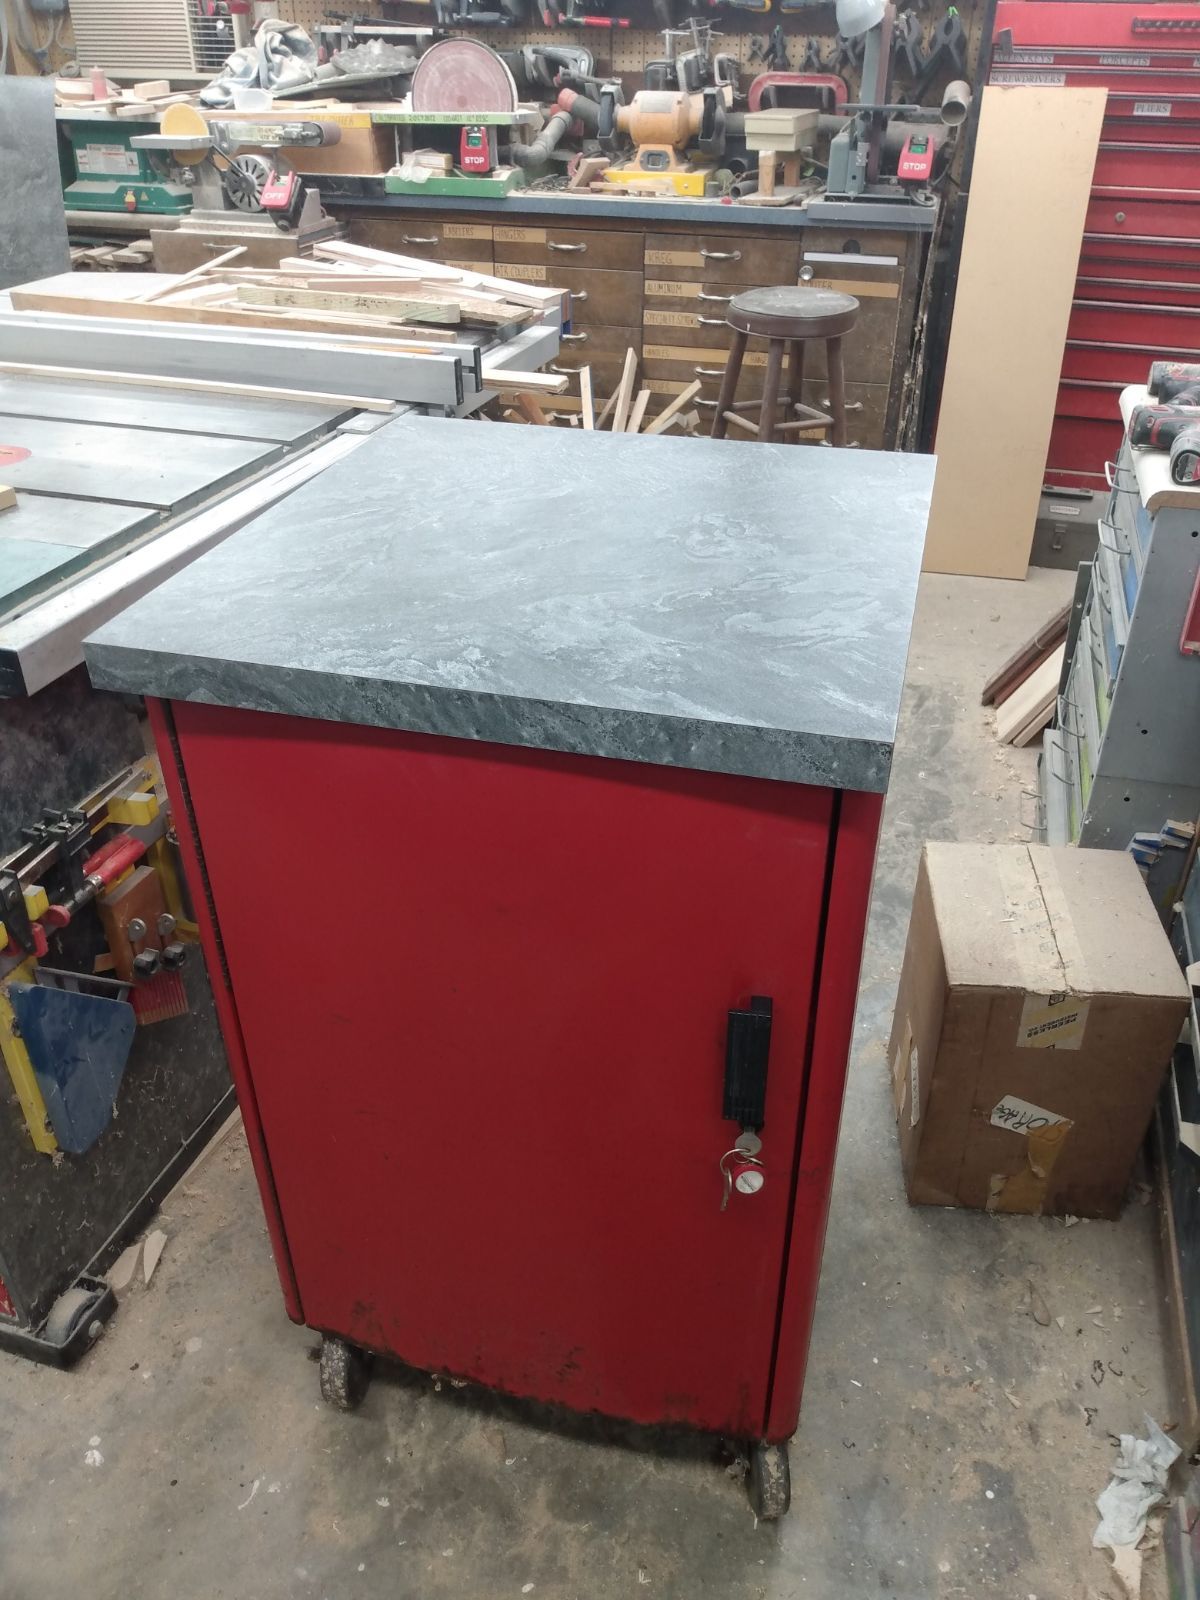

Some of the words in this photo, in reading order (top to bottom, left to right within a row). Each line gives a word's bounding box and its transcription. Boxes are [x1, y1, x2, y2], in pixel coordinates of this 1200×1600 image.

[991, 73, 1062, 83] SCREWDRIVERS
[1135, 104, 1168, 113] PLIERS
[464, 156, 485, 164] STOP
[903, 162, 927, 170] STOP
[263, 191, 285, 200] OFF
[510, 267, 544, 279] COUPLERS
[646, 283, 683, 294] ALUMINUM
